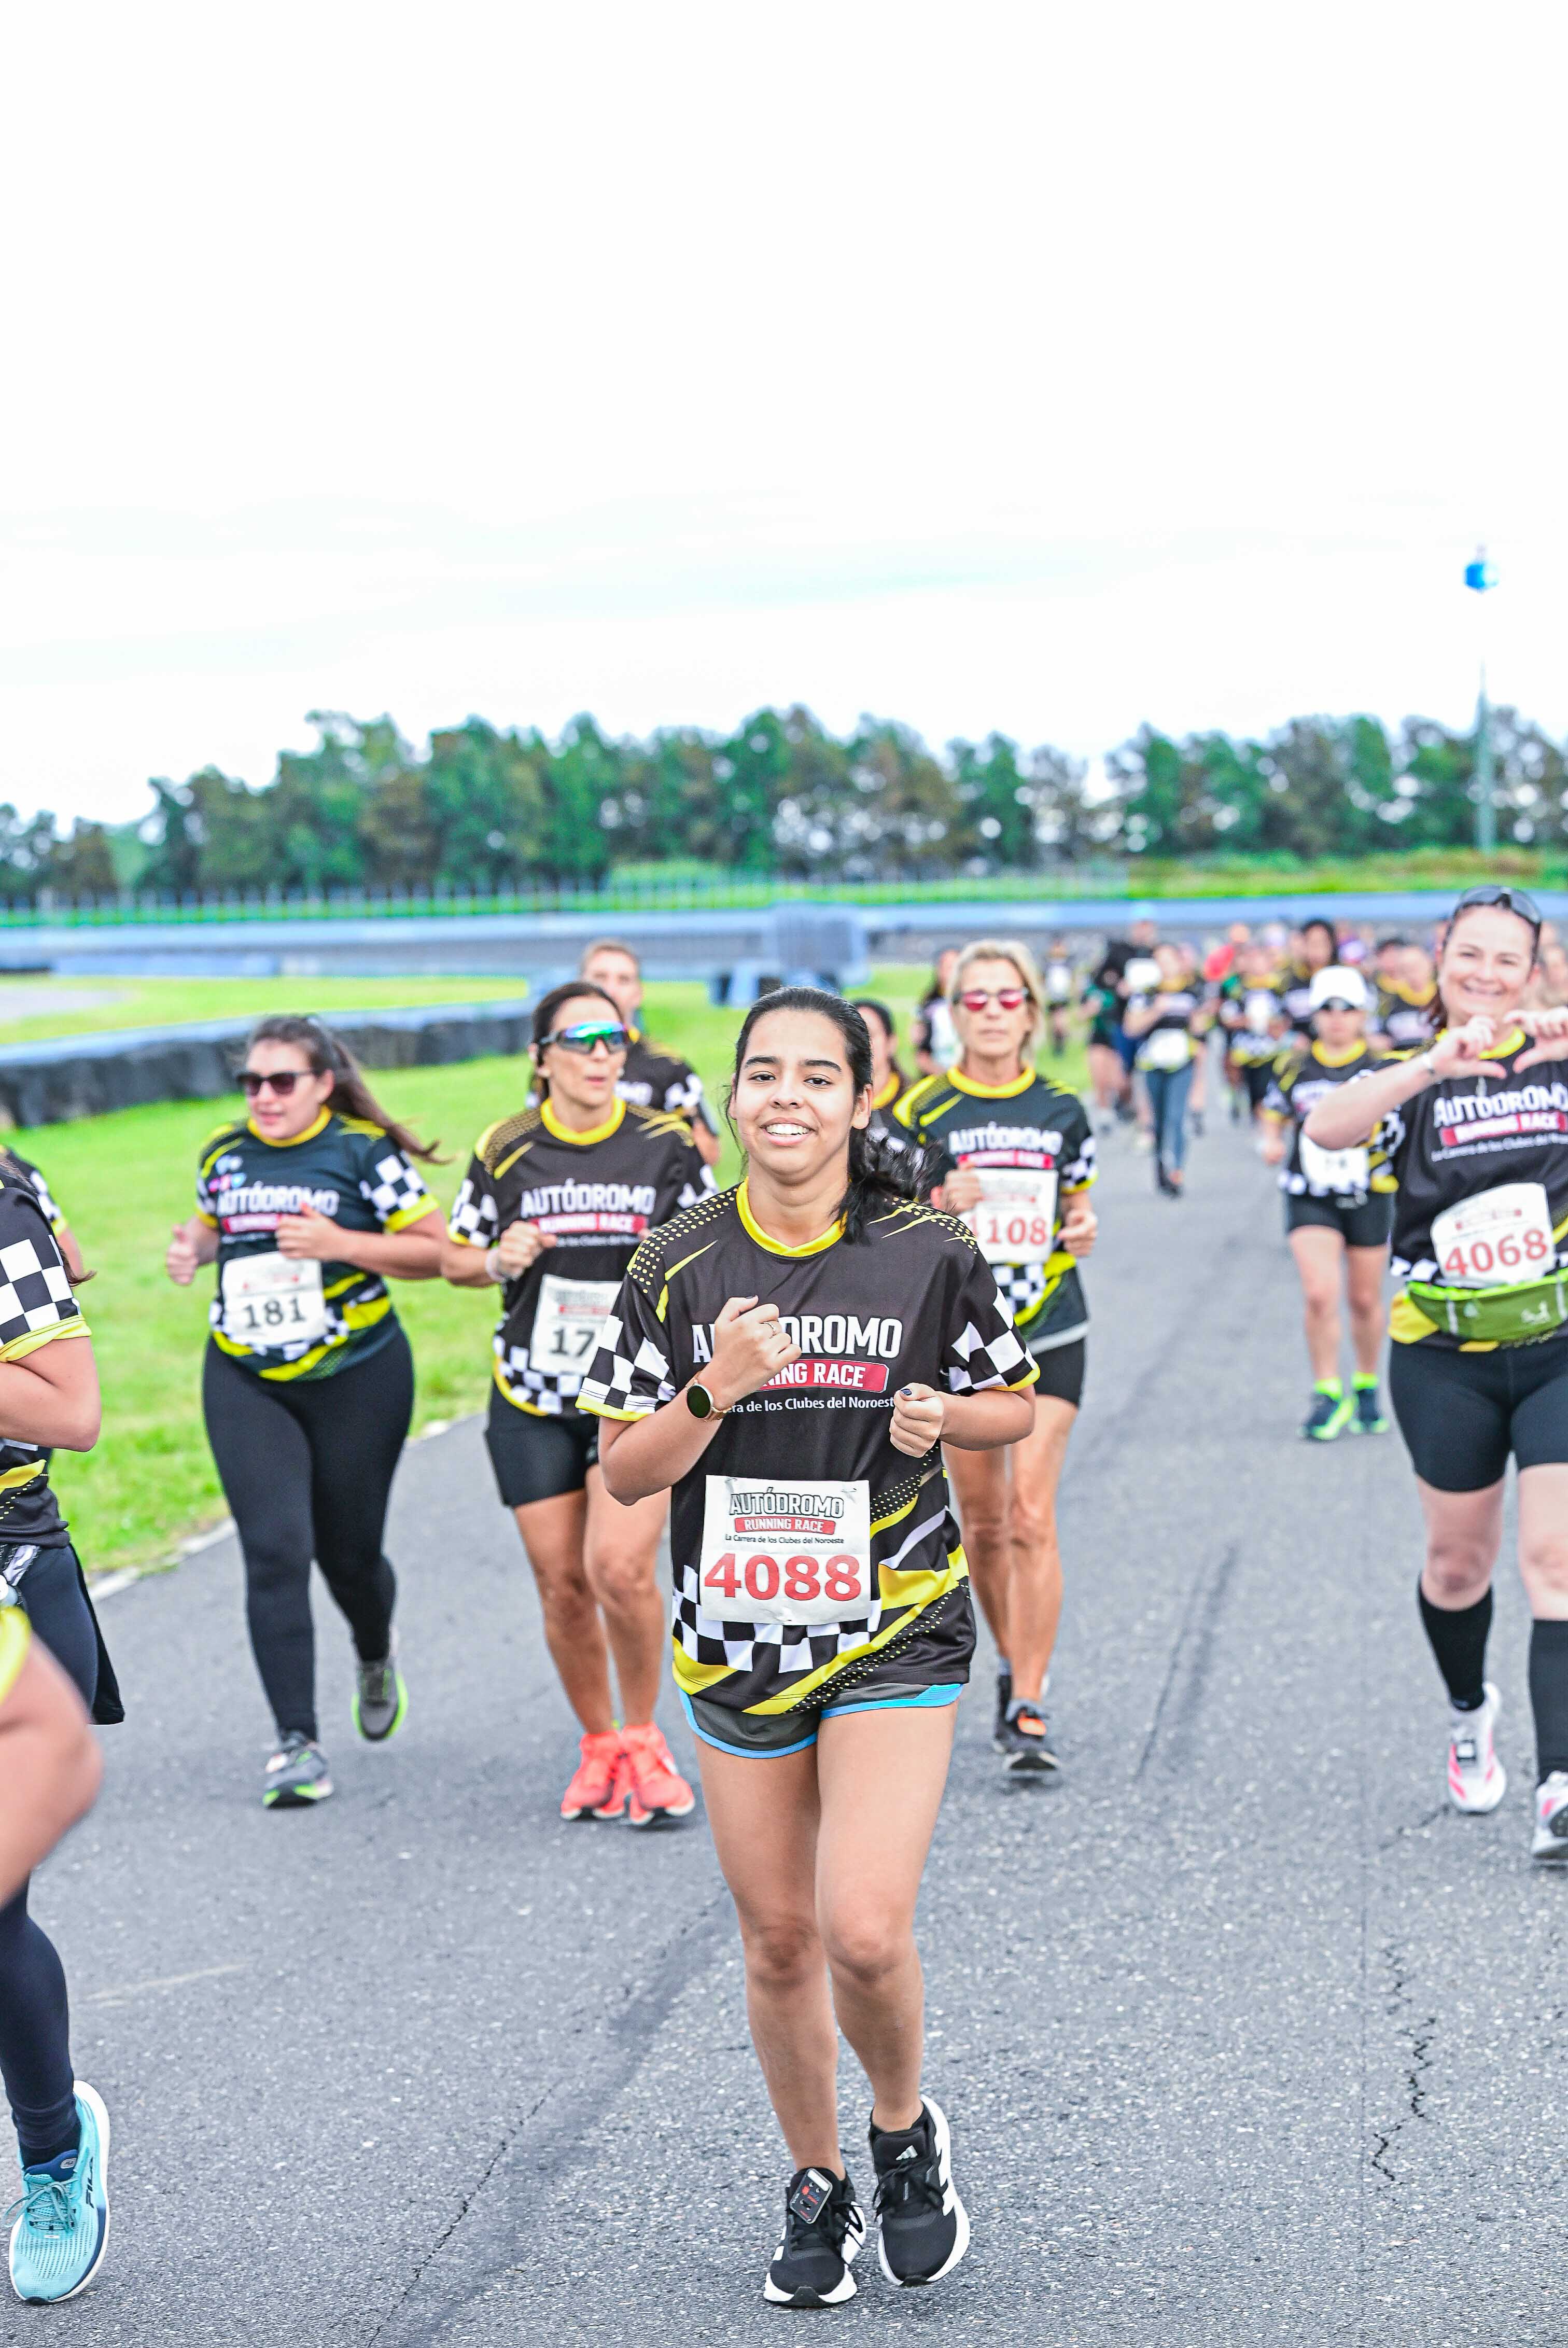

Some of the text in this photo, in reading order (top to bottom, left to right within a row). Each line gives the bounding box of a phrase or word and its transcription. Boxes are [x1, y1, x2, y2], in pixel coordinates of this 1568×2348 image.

[520, 1178, 656, 1218] AUTÓDROMO
[1445, 1228, 1547, 1277] 4068
[243, 1297, 306, 1329] 181
[548, 1326, 595, 1358] 17
[692, 1315, 903, 1363] ADROMO
[813, 1363, 865, 1387] RACE
[746, 1401, 762, 1412] de
[765, 1400, 782, 1411] los
[785, 1397, 824, 1409] Clubes
[827, 1396, 845, 1408] del
[849, 1396, 894, 1408] Noroest
[729, 1487, 844, 1518] AUTÓDROMO
[744, 1518, 824, 1532] RUNNING RACE
[704, 1553, 861, 1601] 4088
[86, 2157, 94, 2209] FILA
